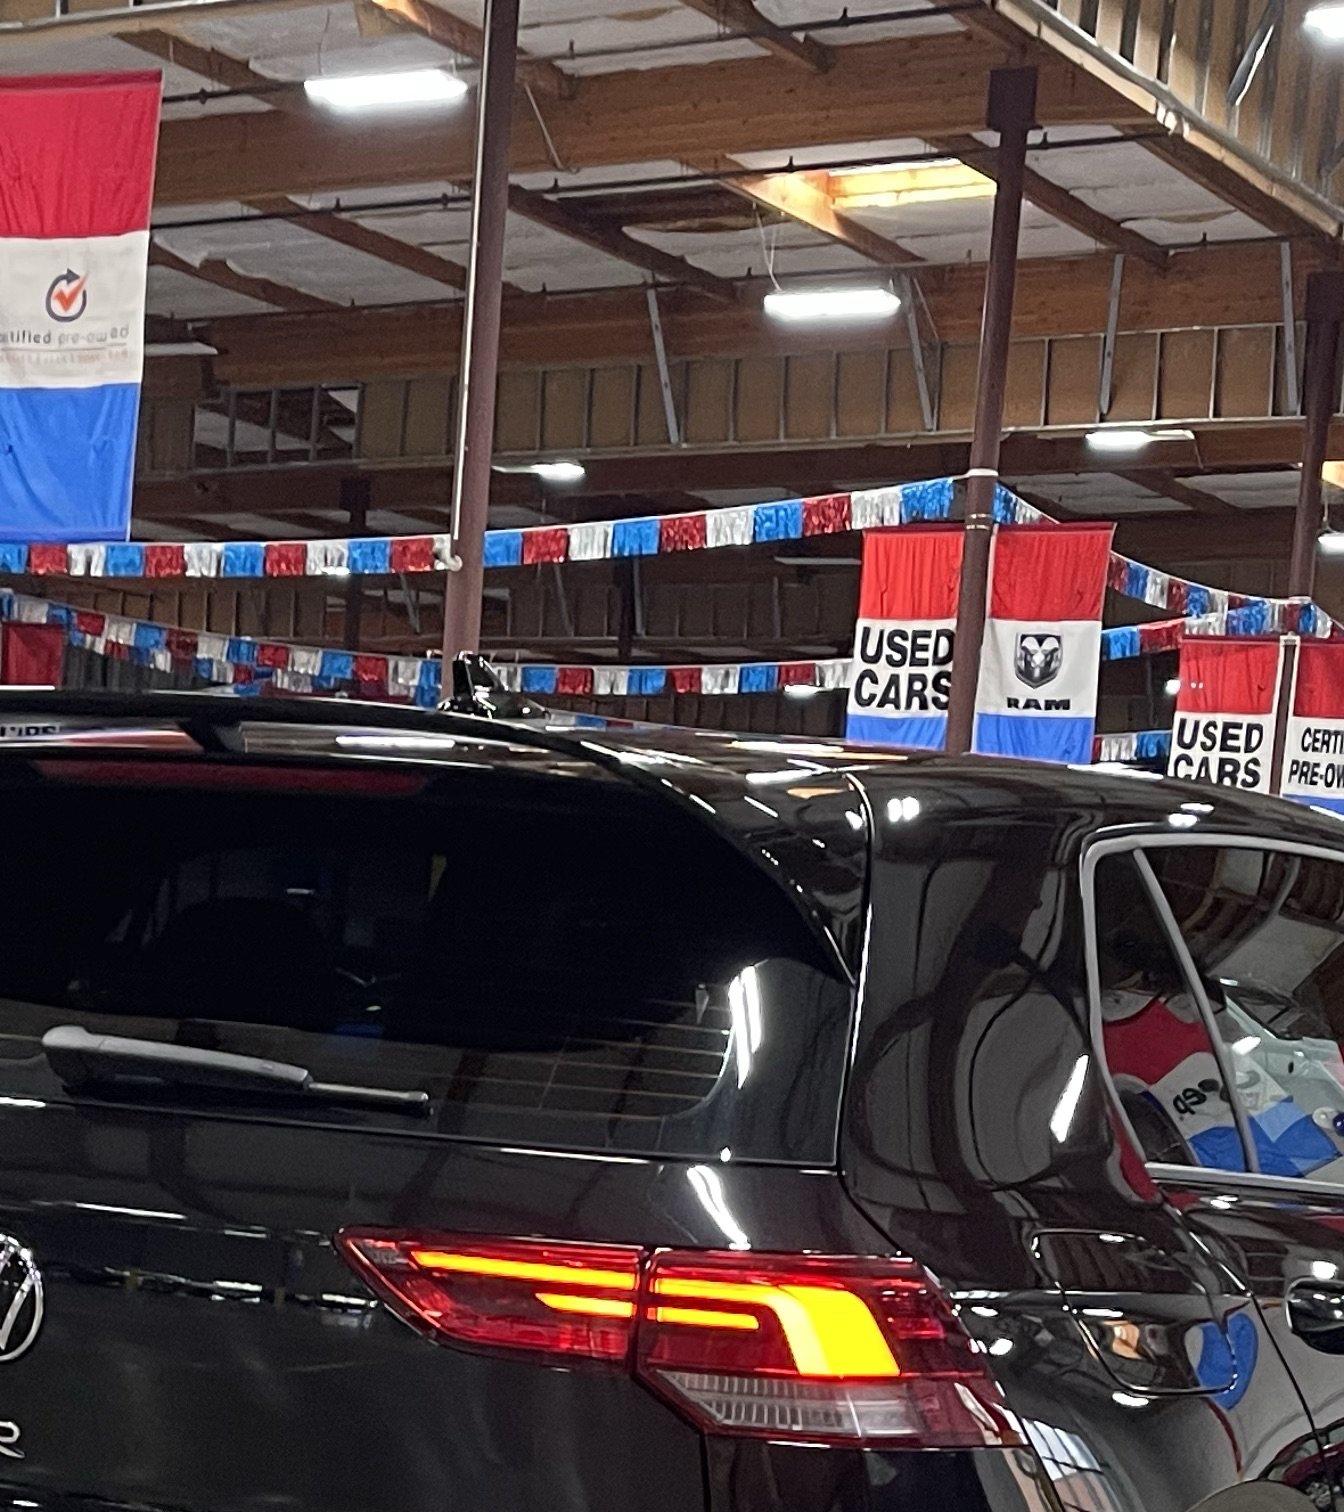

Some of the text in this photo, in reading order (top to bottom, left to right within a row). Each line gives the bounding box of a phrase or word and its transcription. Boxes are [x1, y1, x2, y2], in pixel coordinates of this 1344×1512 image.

[57, 325, 130, 346] pre-owed
[860, 626, 956, 667] USED
[854, 668, 953, 711] CARS
[1006, 697, 1071, 711] RAM
[1176, 718, 1264, 753] USED
[1173, 753, 1262, 789] CARS
